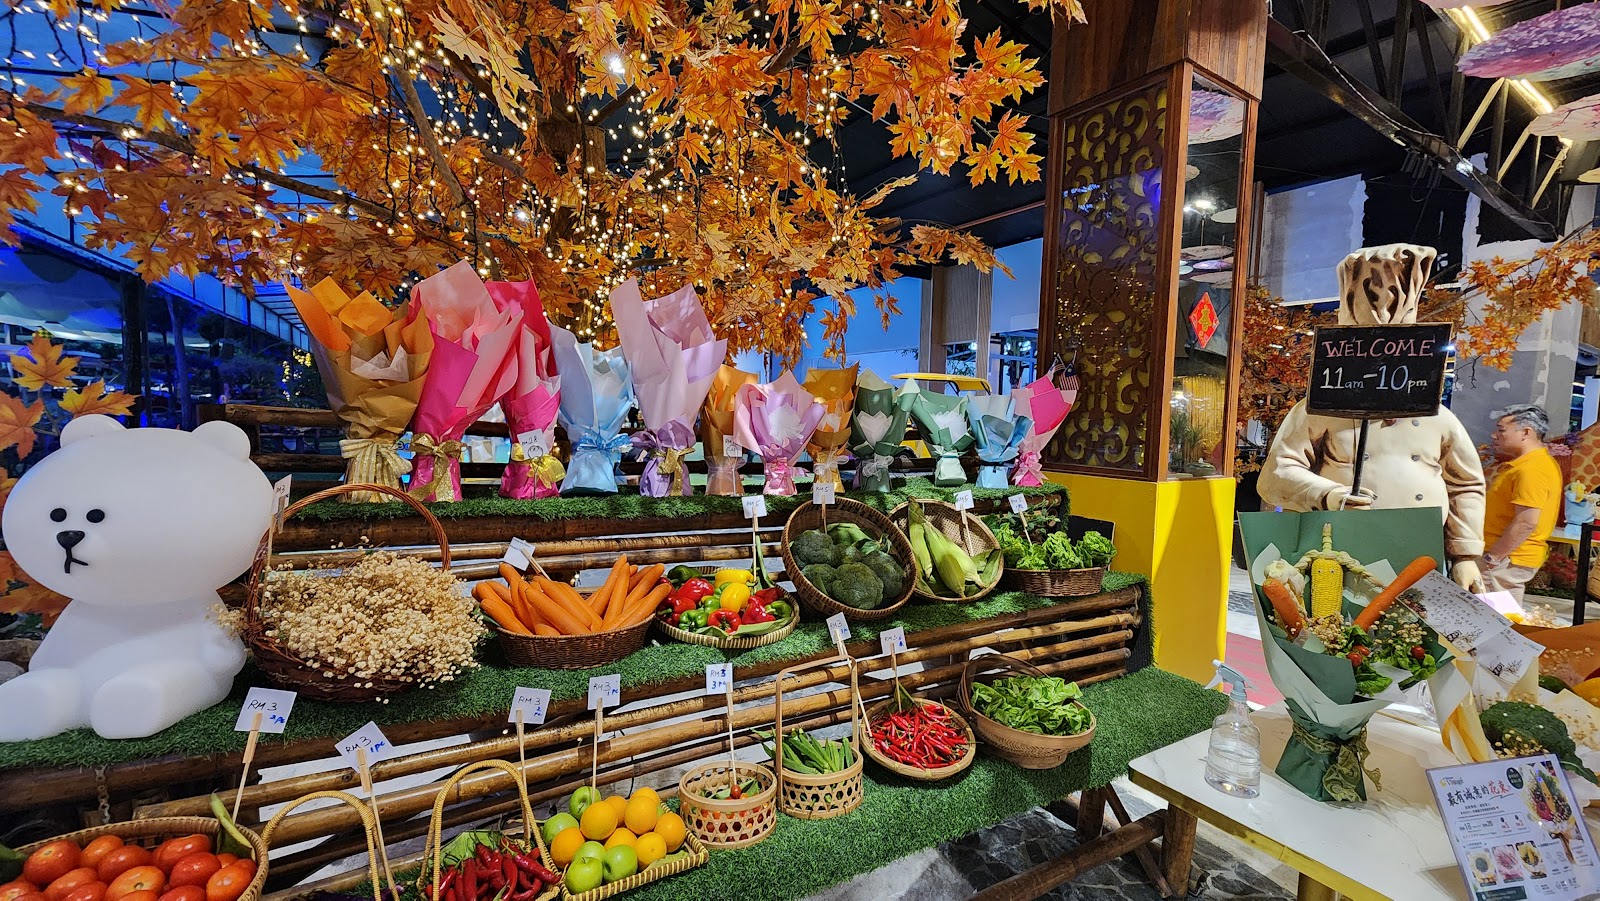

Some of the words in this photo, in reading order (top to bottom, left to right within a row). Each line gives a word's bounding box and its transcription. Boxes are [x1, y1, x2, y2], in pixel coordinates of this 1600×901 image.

[1322, 335, 1436, 358] WELCOME
[1447, 780, 1510, 807] 最有诚意的花束
